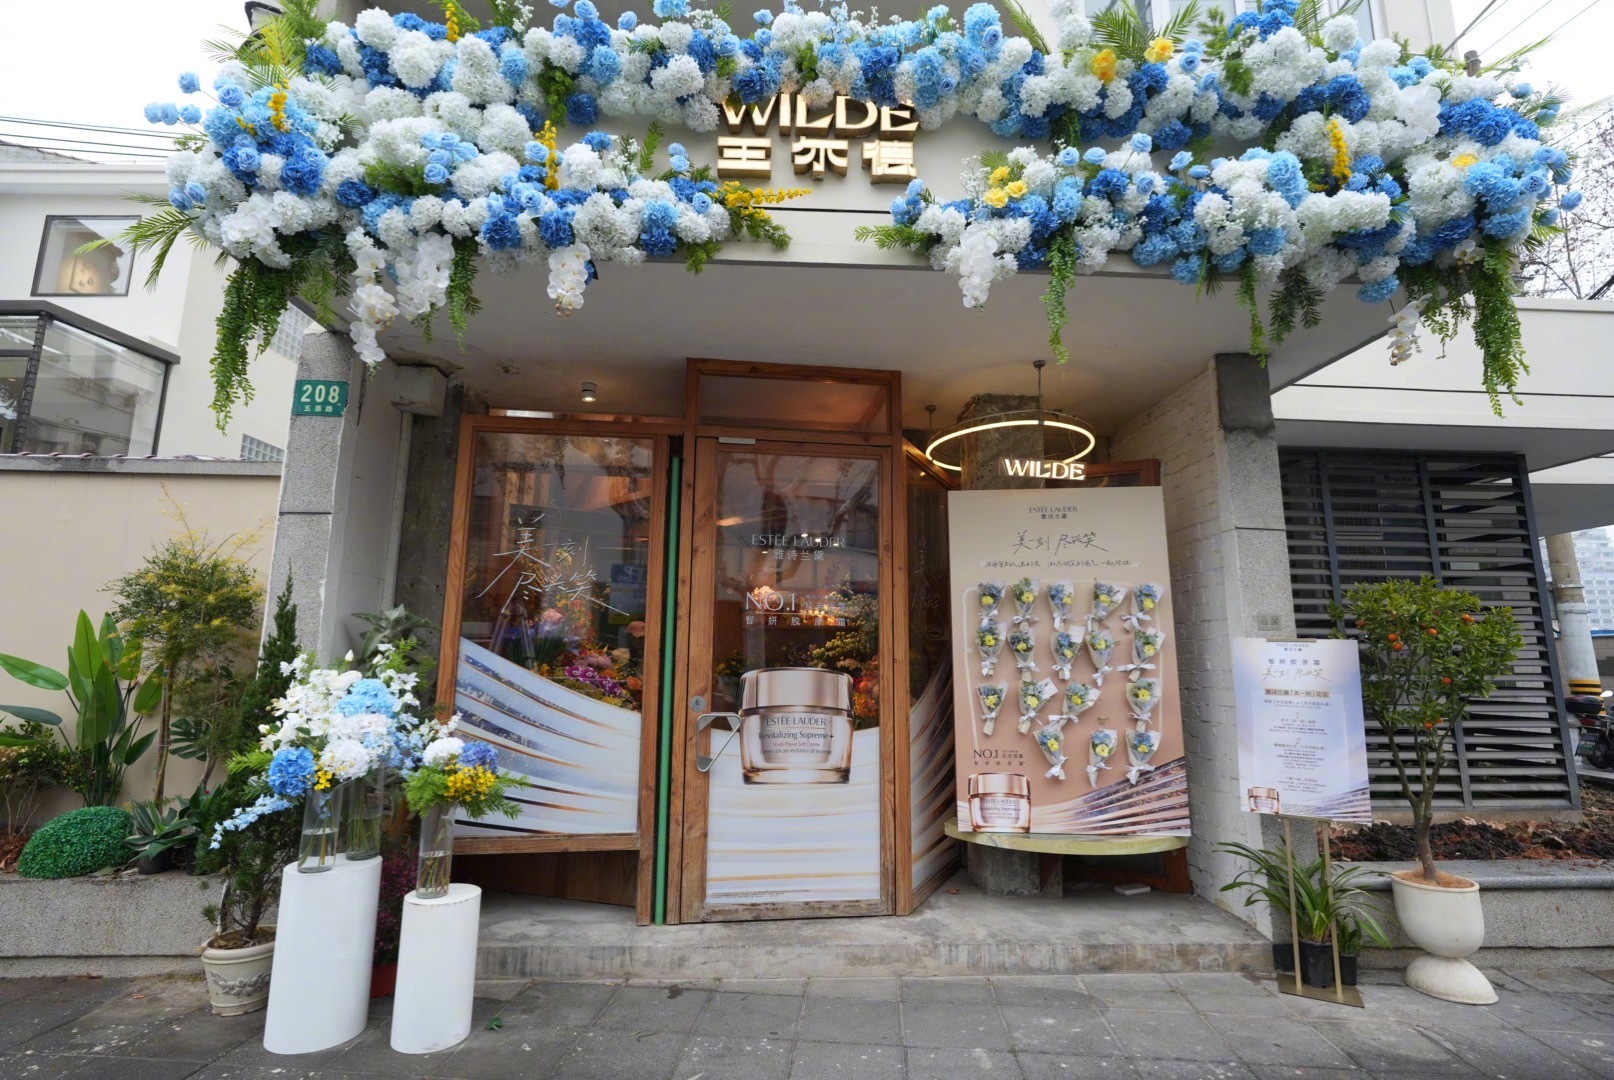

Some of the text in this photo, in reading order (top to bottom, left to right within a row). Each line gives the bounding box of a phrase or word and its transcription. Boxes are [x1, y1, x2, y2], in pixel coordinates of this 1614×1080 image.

[721, 93, 919, 138] WILDE
[717, 136, 917, 181] 王尔德
[300, 384, 340, 403] 208
[1004, 458, 1086, 481] WILDE
[793, 535, 847, 549] LAUDER
[773, 549, 825, 561] 雅诗兰黛
[746, 591, 796, 611] NO.1
[793, 717, 827, 726] LAUDER
[759, 730, 798, 740] Revitalizing
[973, 749, 999, 759] NO.1
